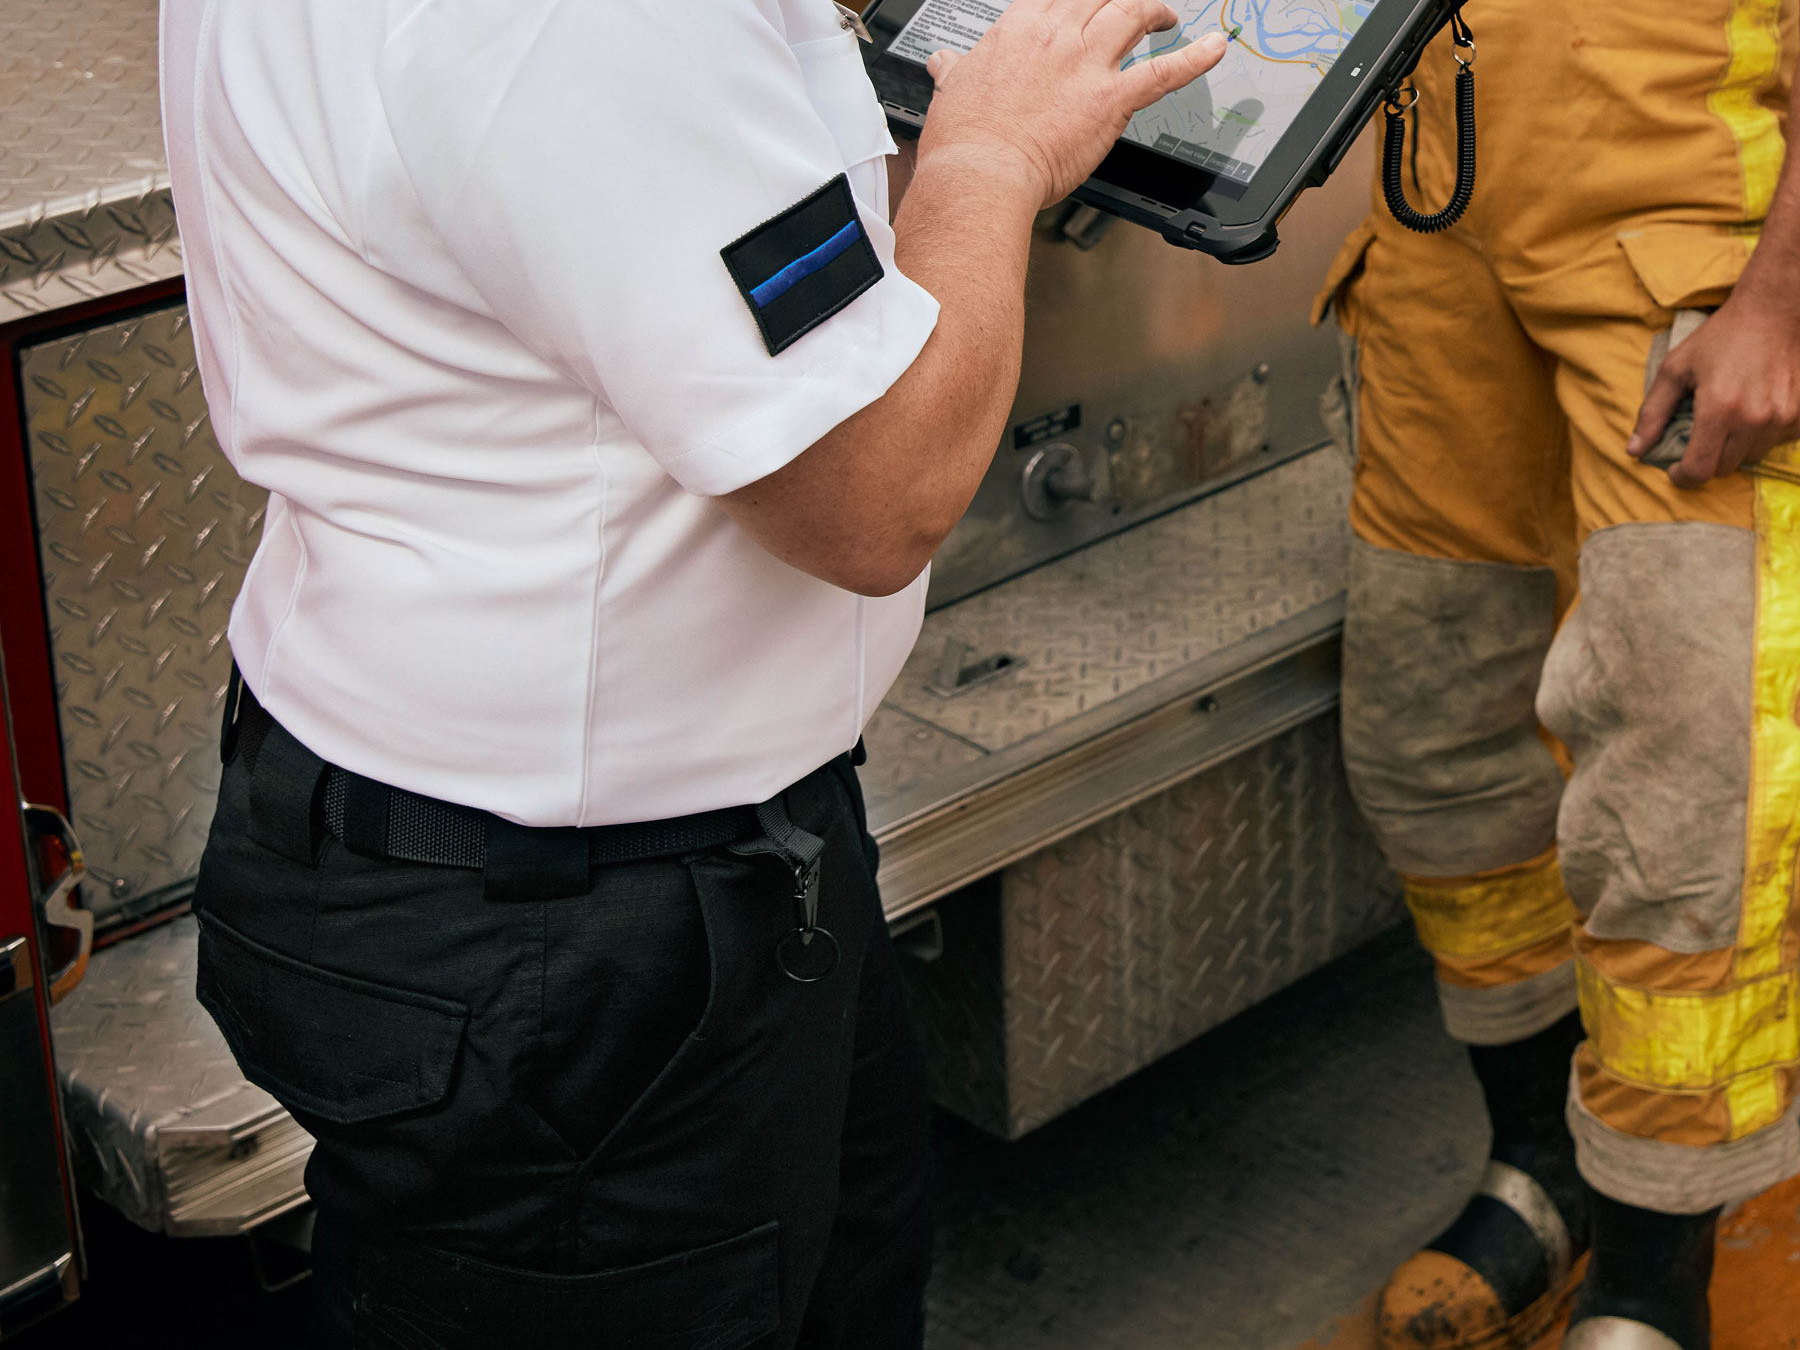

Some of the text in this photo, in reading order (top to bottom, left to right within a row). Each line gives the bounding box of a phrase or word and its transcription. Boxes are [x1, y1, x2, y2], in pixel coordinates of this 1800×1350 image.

[1158, 139, 1175, 148] Views
[1178, 146, 1195, 155] Street
[1210, 157, 1236, 169] Directions
